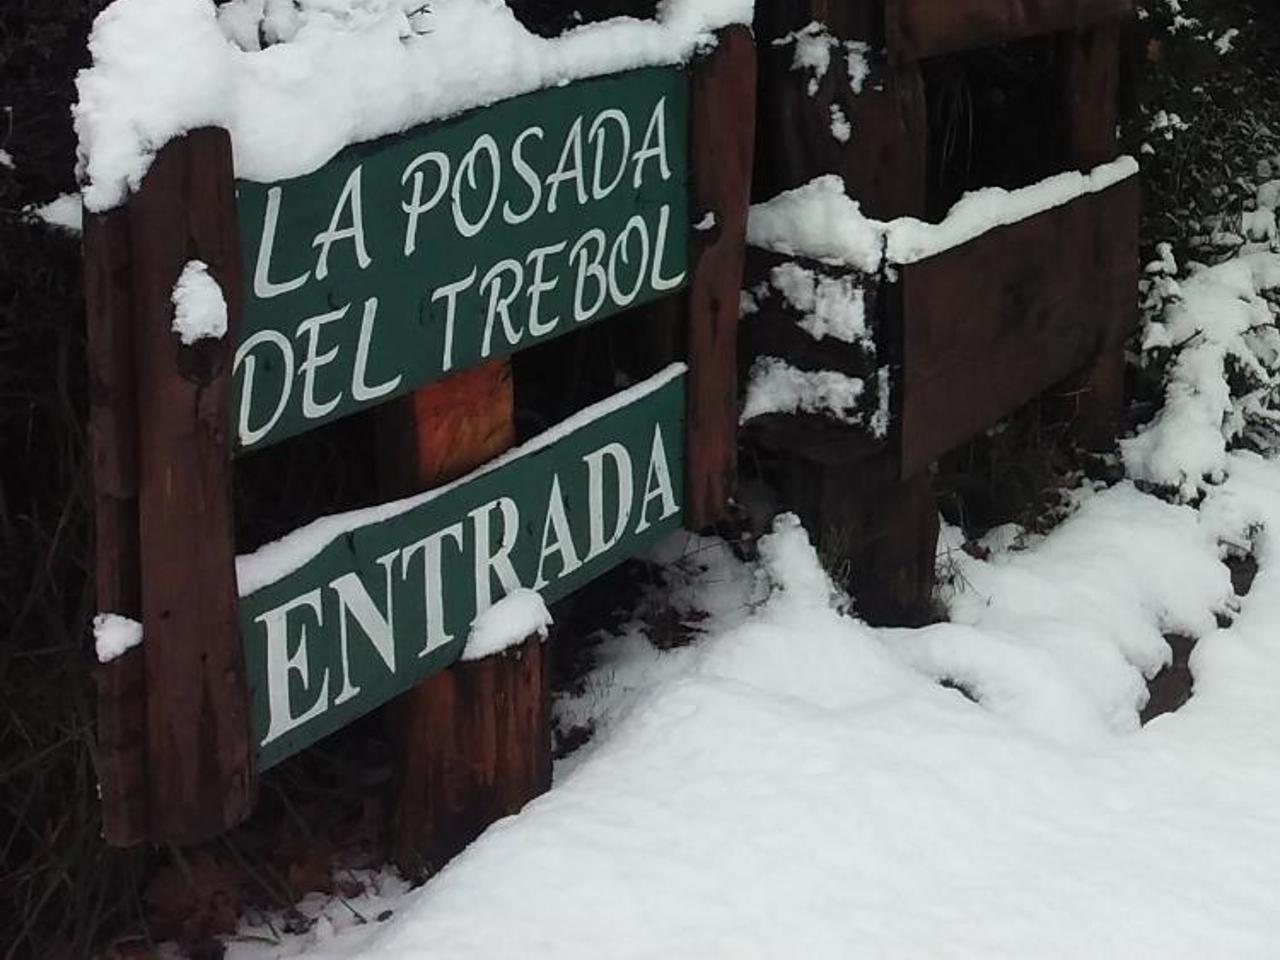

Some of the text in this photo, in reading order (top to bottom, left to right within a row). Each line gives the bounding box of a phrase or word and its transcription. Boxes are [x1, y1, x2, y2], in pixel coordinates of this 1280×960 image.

[253, 96, 672, 298] LA POSADA
[232, 205, 686, 447] DEL TREBOL
[254, 421, 681, 748] ENTRADA
